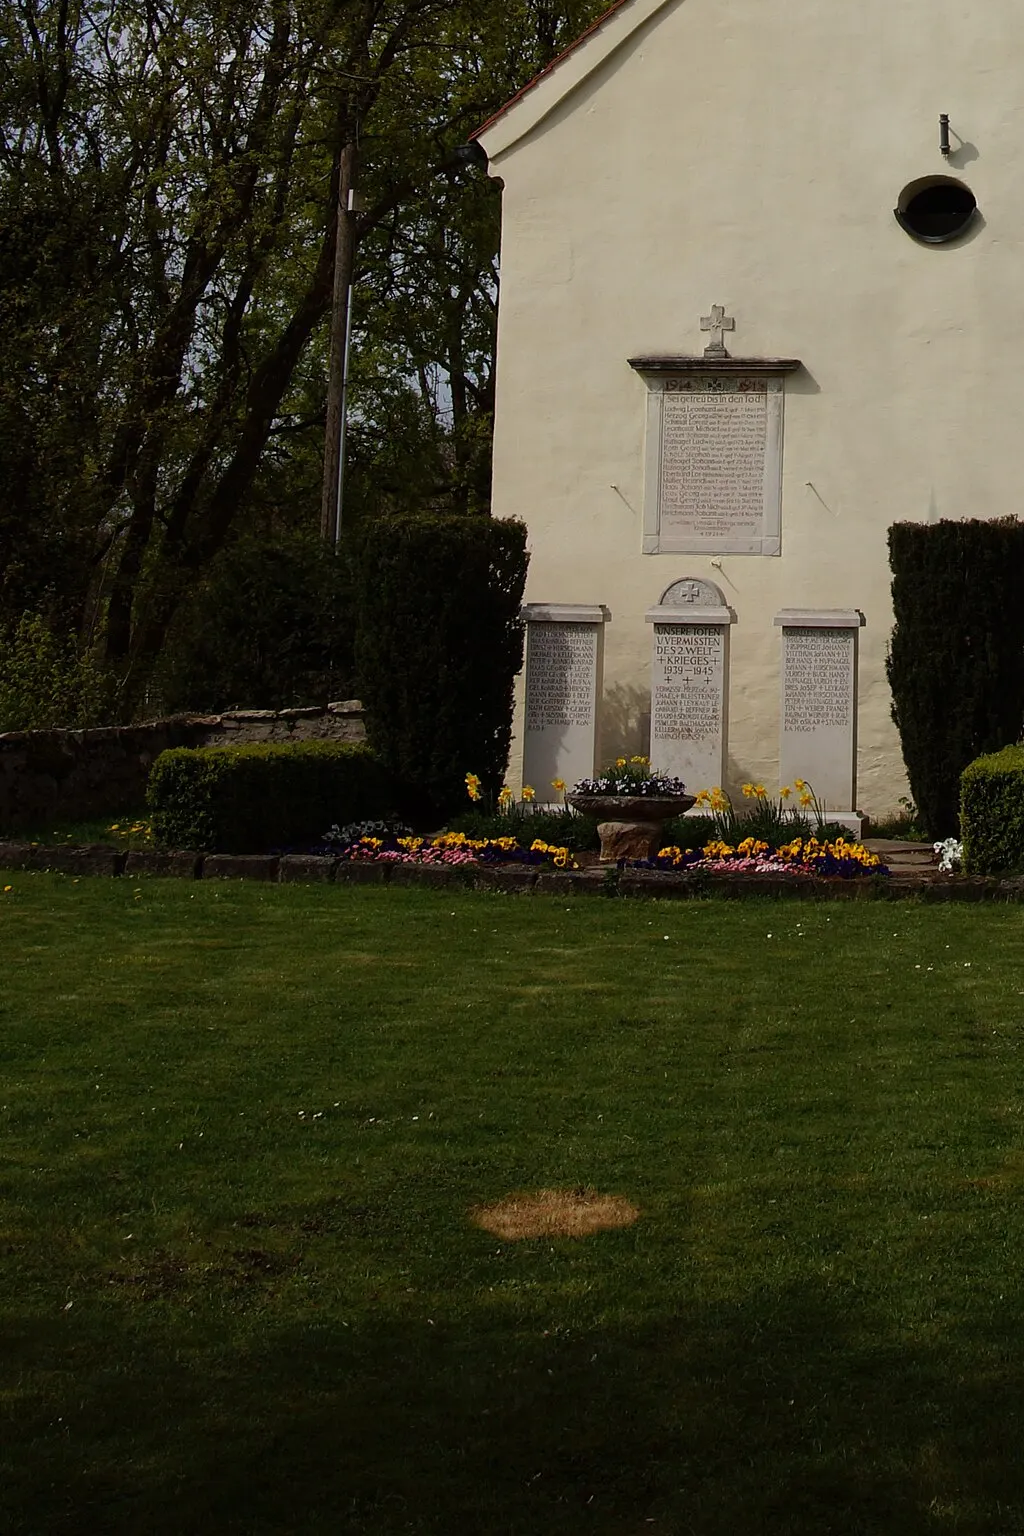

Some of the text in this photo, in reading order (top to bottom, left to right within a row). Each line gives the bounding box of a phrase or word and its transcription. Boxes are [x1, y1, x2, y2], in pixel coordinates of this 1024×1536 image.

[657, 627, 720, 636] UNSERE TOTEN
[657, 646, 676, 654] DES
[667, 656, 709, 665] KRIEGES
